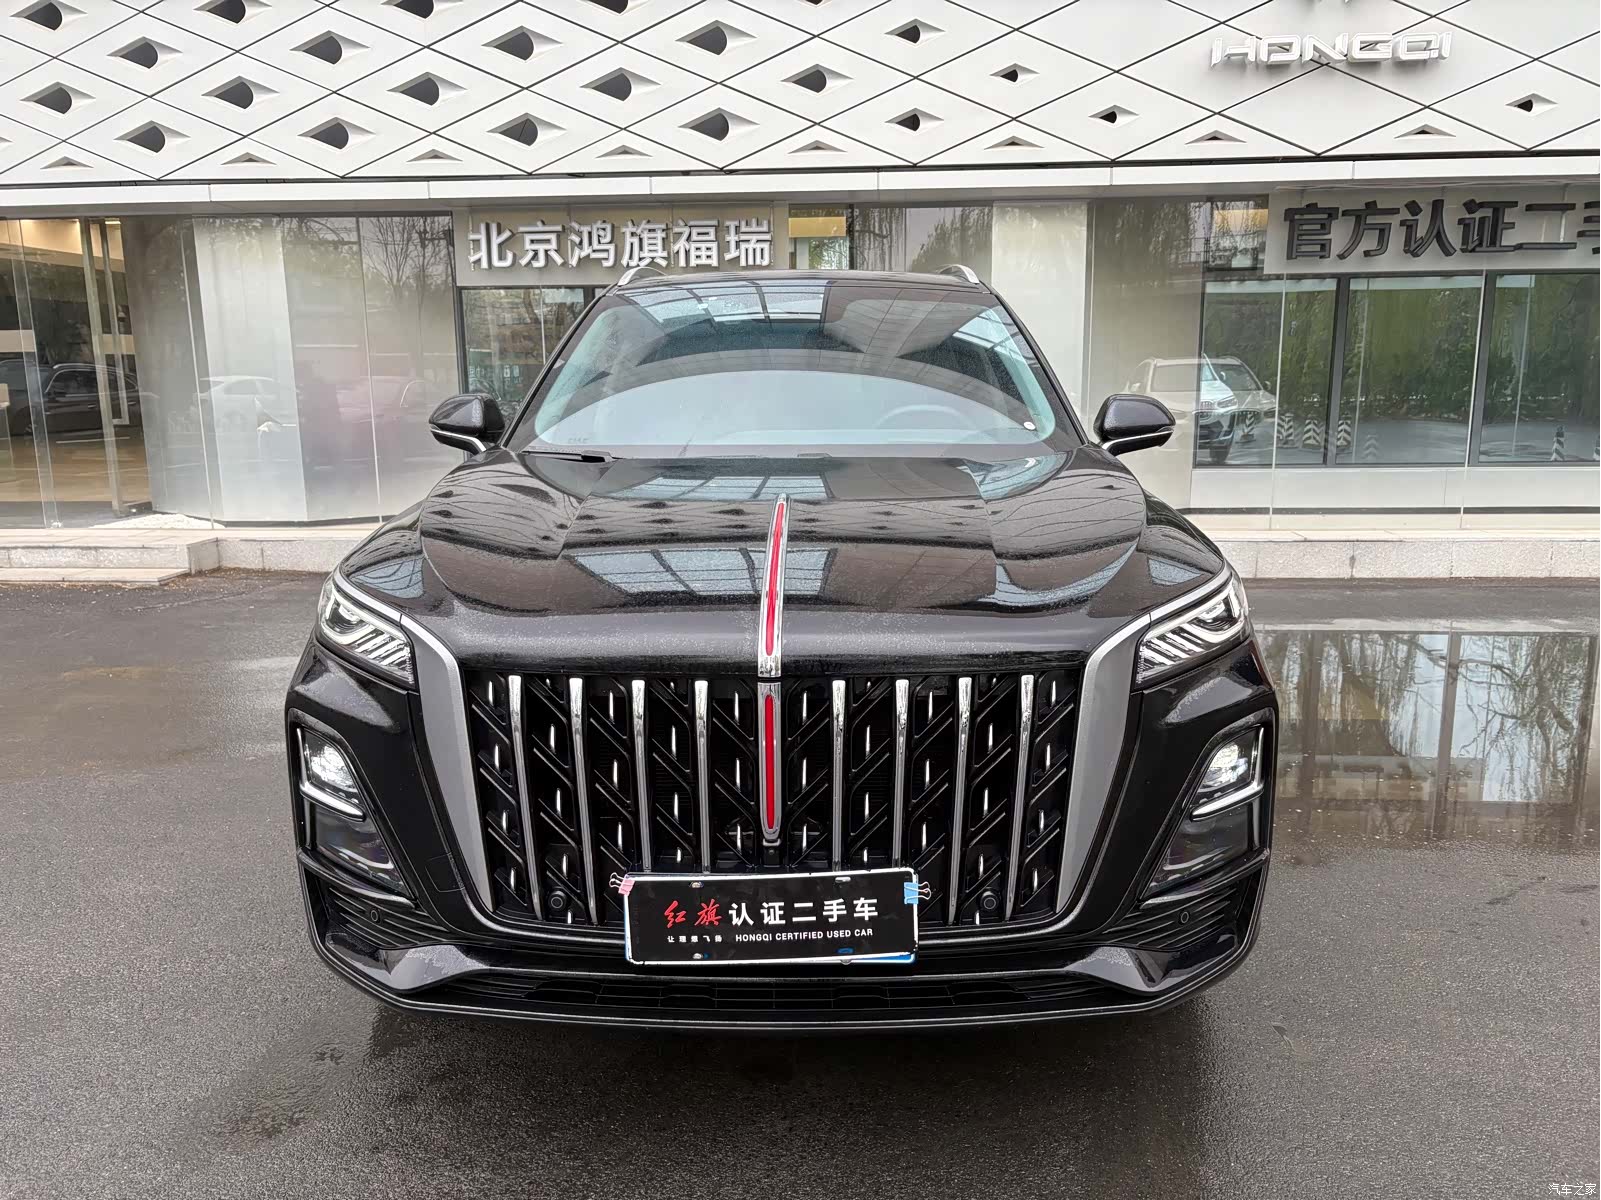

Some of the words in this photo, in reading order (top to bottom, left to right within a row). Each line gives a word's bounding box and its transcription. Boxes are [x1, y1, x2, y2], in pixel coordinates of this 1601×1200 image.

[1211, 32, 1453, 67] HONGQI
[468, 218, 774, 269] 北京鸿旗福瑞
[735, 933, 773, 943] HONGQI
[775, 931, 824, 941] CERTIFIED
[826, 930, 852, 939] USED
[854, 928, 874, 937] CAR
